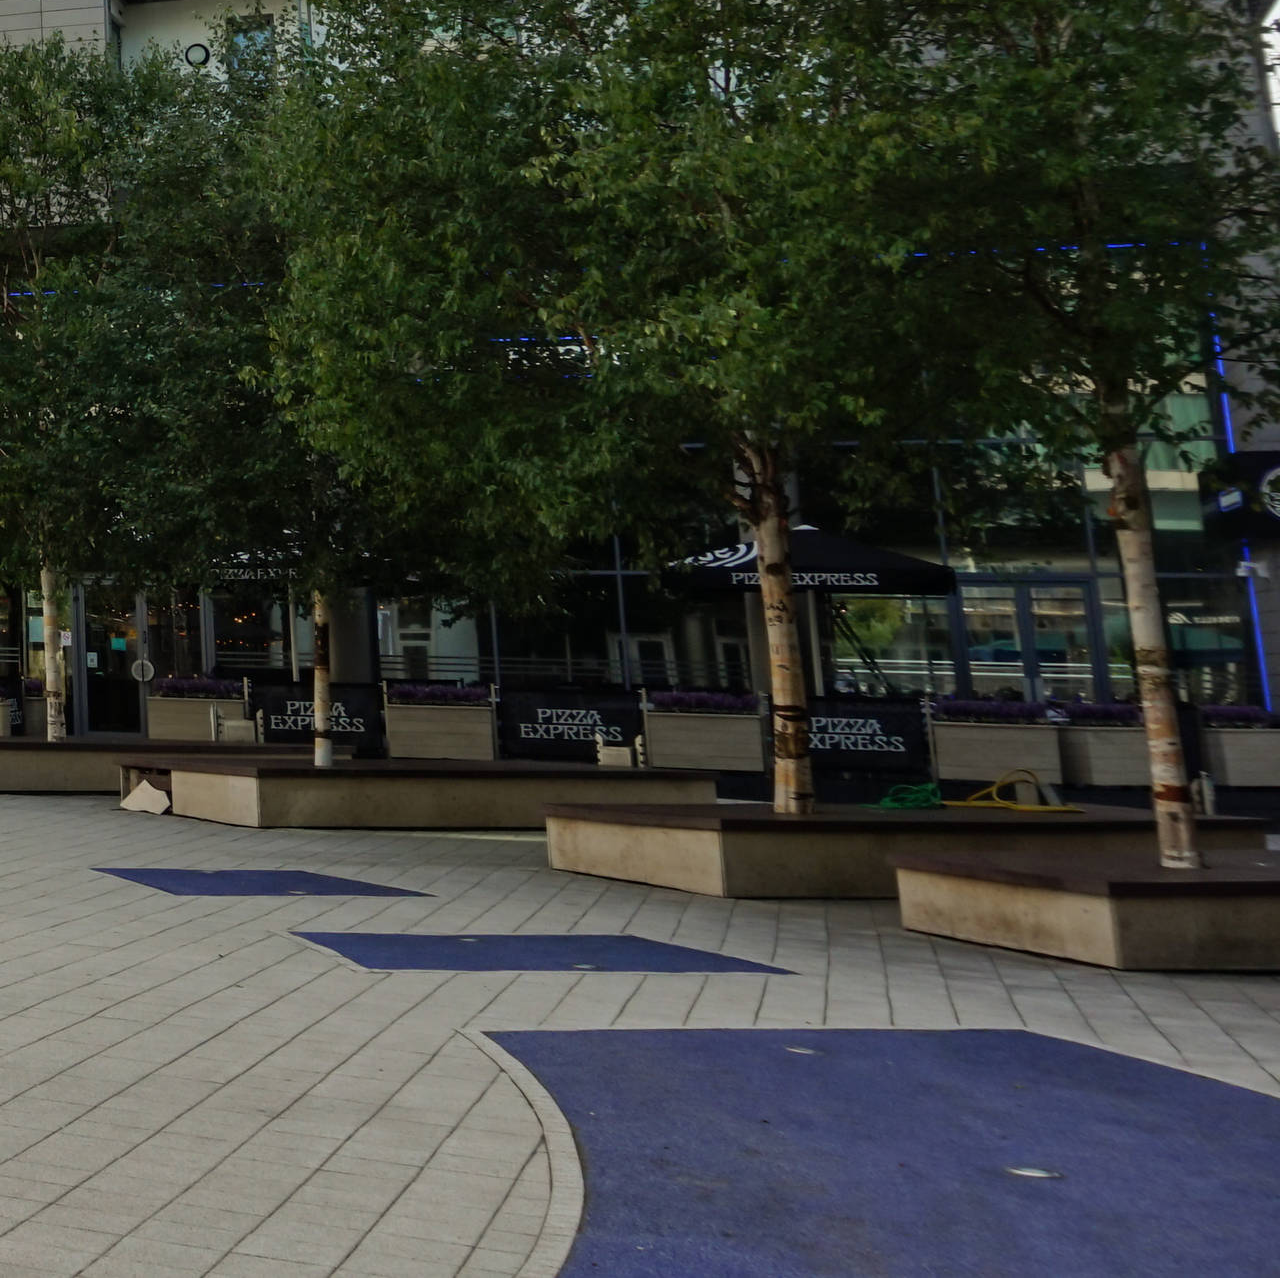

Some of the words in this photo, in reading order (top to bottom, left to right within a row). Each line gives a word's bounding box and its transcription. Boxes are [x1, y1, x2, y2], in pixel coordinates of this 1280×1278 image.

[285, 700, 349, 717] PIZA
[536, 708, 606, 725] PIZZA
[270, 714, 366, 732] EXPESS
[519, 723, 624, 741] EXPRESS
[809, 717, 884, 735] PIZZA
[807, 733, 906, 752] XPRESS
